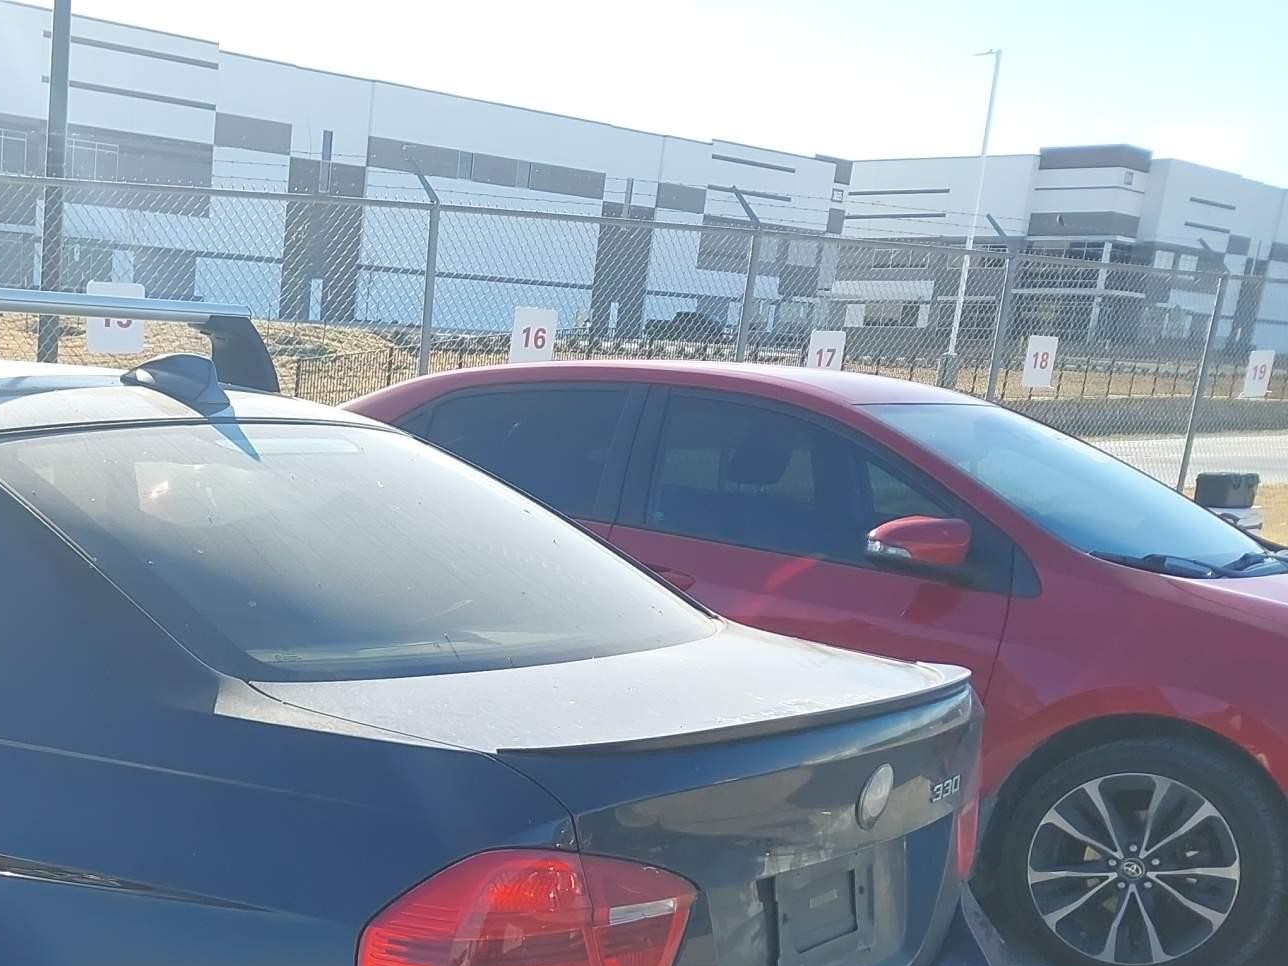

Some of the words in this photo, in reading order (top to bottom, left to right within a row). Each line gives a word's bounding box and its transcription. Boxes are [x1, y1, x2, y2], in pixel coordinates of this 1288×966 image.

[521, 325, 547, 350] 16
[815, 347, 838, 368] 17
[1032, 352, 1050, 370] 18
[1251, 363, 1268, 381] 19
[931, 774, 961, 803] 330
